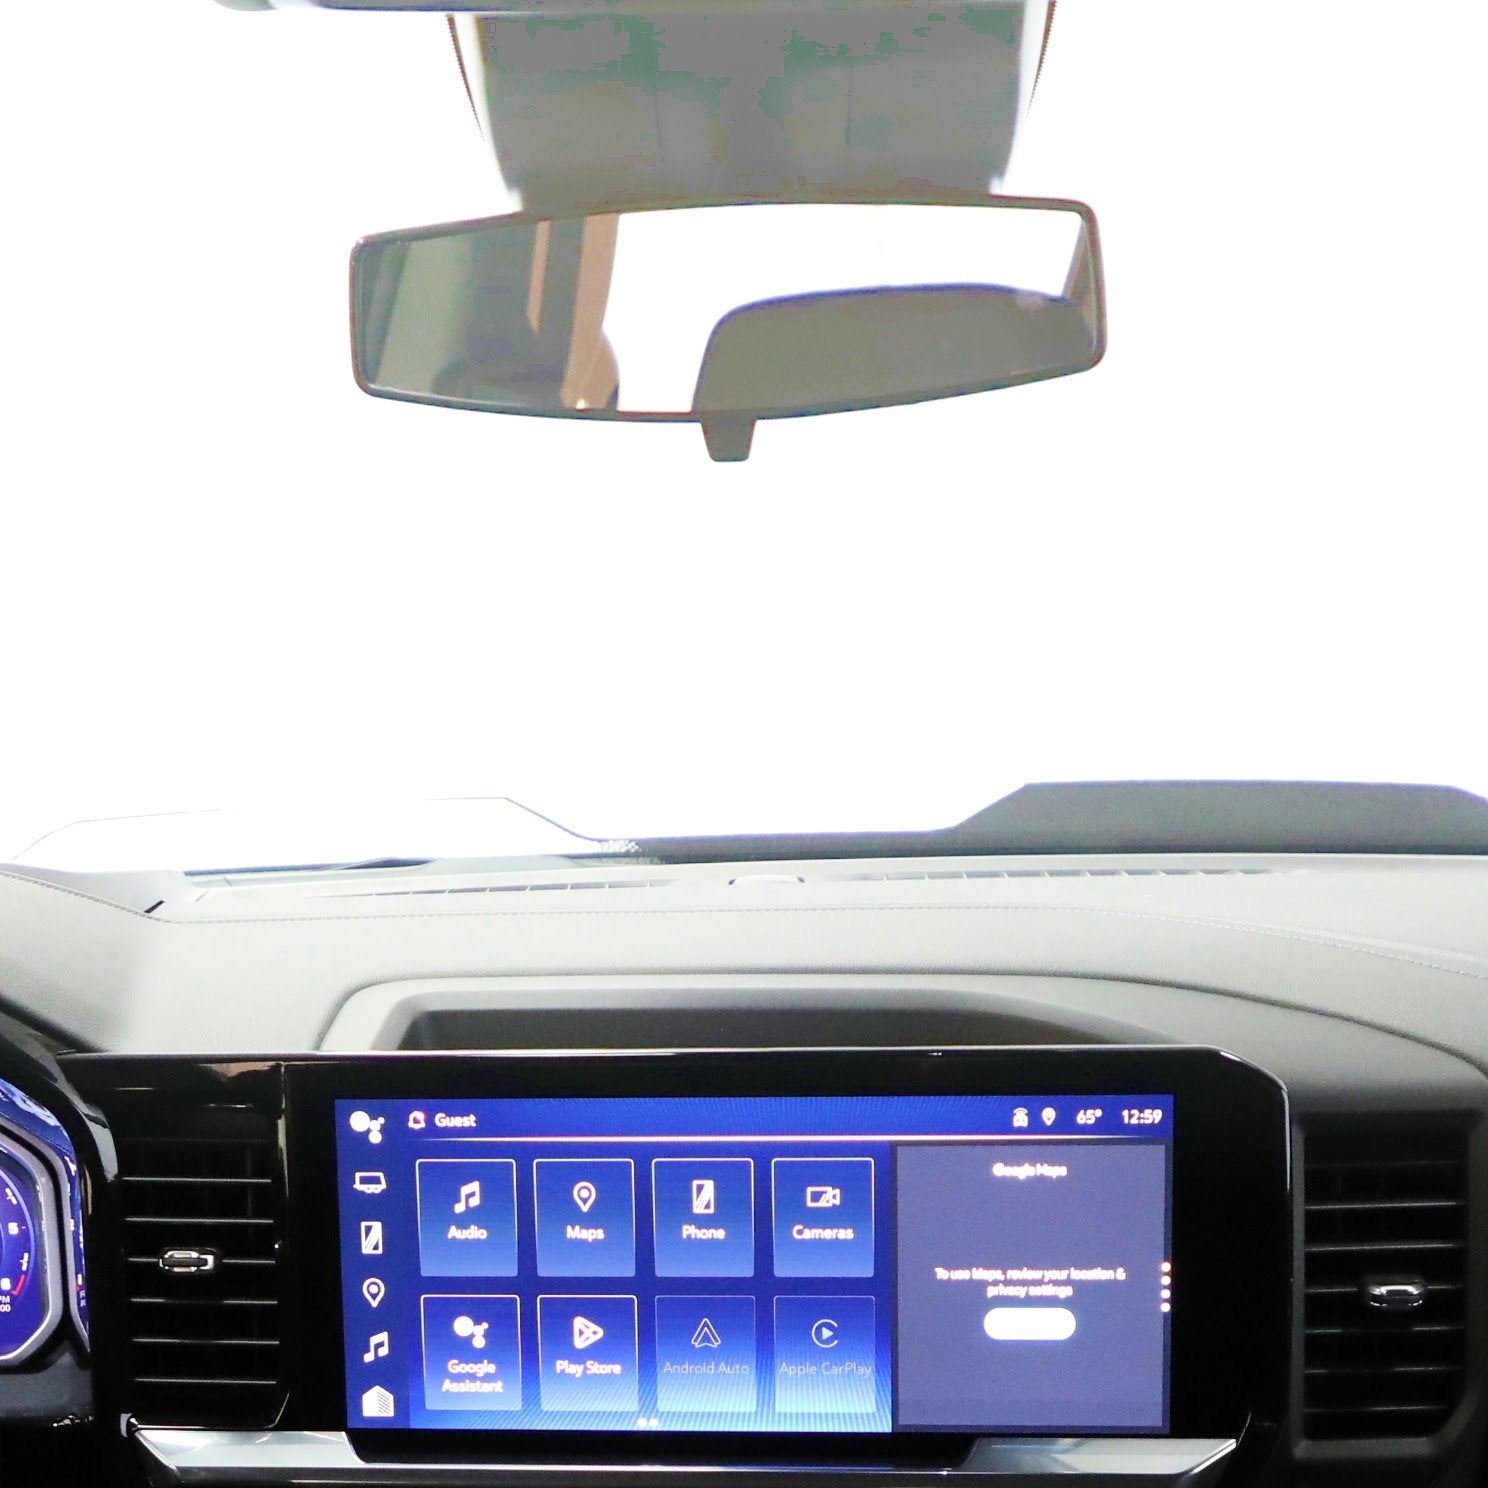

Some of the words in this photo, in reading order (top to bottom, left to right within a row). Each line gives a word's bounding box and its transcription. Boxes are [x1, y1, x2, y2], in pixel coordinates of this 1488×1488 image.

[434, 1112, 477, 1128] Guest
[1122, 1108, 1163, 1125] 12:59
[992, 1162, 1035, 1180] Google
[1036, 1162, 1068, 1179] Maps
[447, 1225, 488, 1240] Audio
[566, 1225, 605, 1243] Maps
[681, 1225, 726, 1240] Phone
[792, 1225, 855, 1240] Cameras
[935, 1267, 949, 1281] To
[950, 1269, 971, 1281] use
[1006, 1267, 1043, 1281] review
[1043, 1268, 1069, 1282] your
[1070, 1267, 1114, 1281] location
[987, 1283, 1027, 1298] privacy
[1028, 1283, 1074, 1299] settings
[447, 1359, 496, 1377] Google
[555, 1360, 583, 1378] Play
[586, 1361, 622, 1375] Store
[662, 1361, 715, 1375] Android
[717, 1361, 750, 1375] Auto
[778, 1362, 818, 1378] Apple
[821, 1362, 872, 1378] CarPlay
[442, 1379, 504, 1393] Assistant
